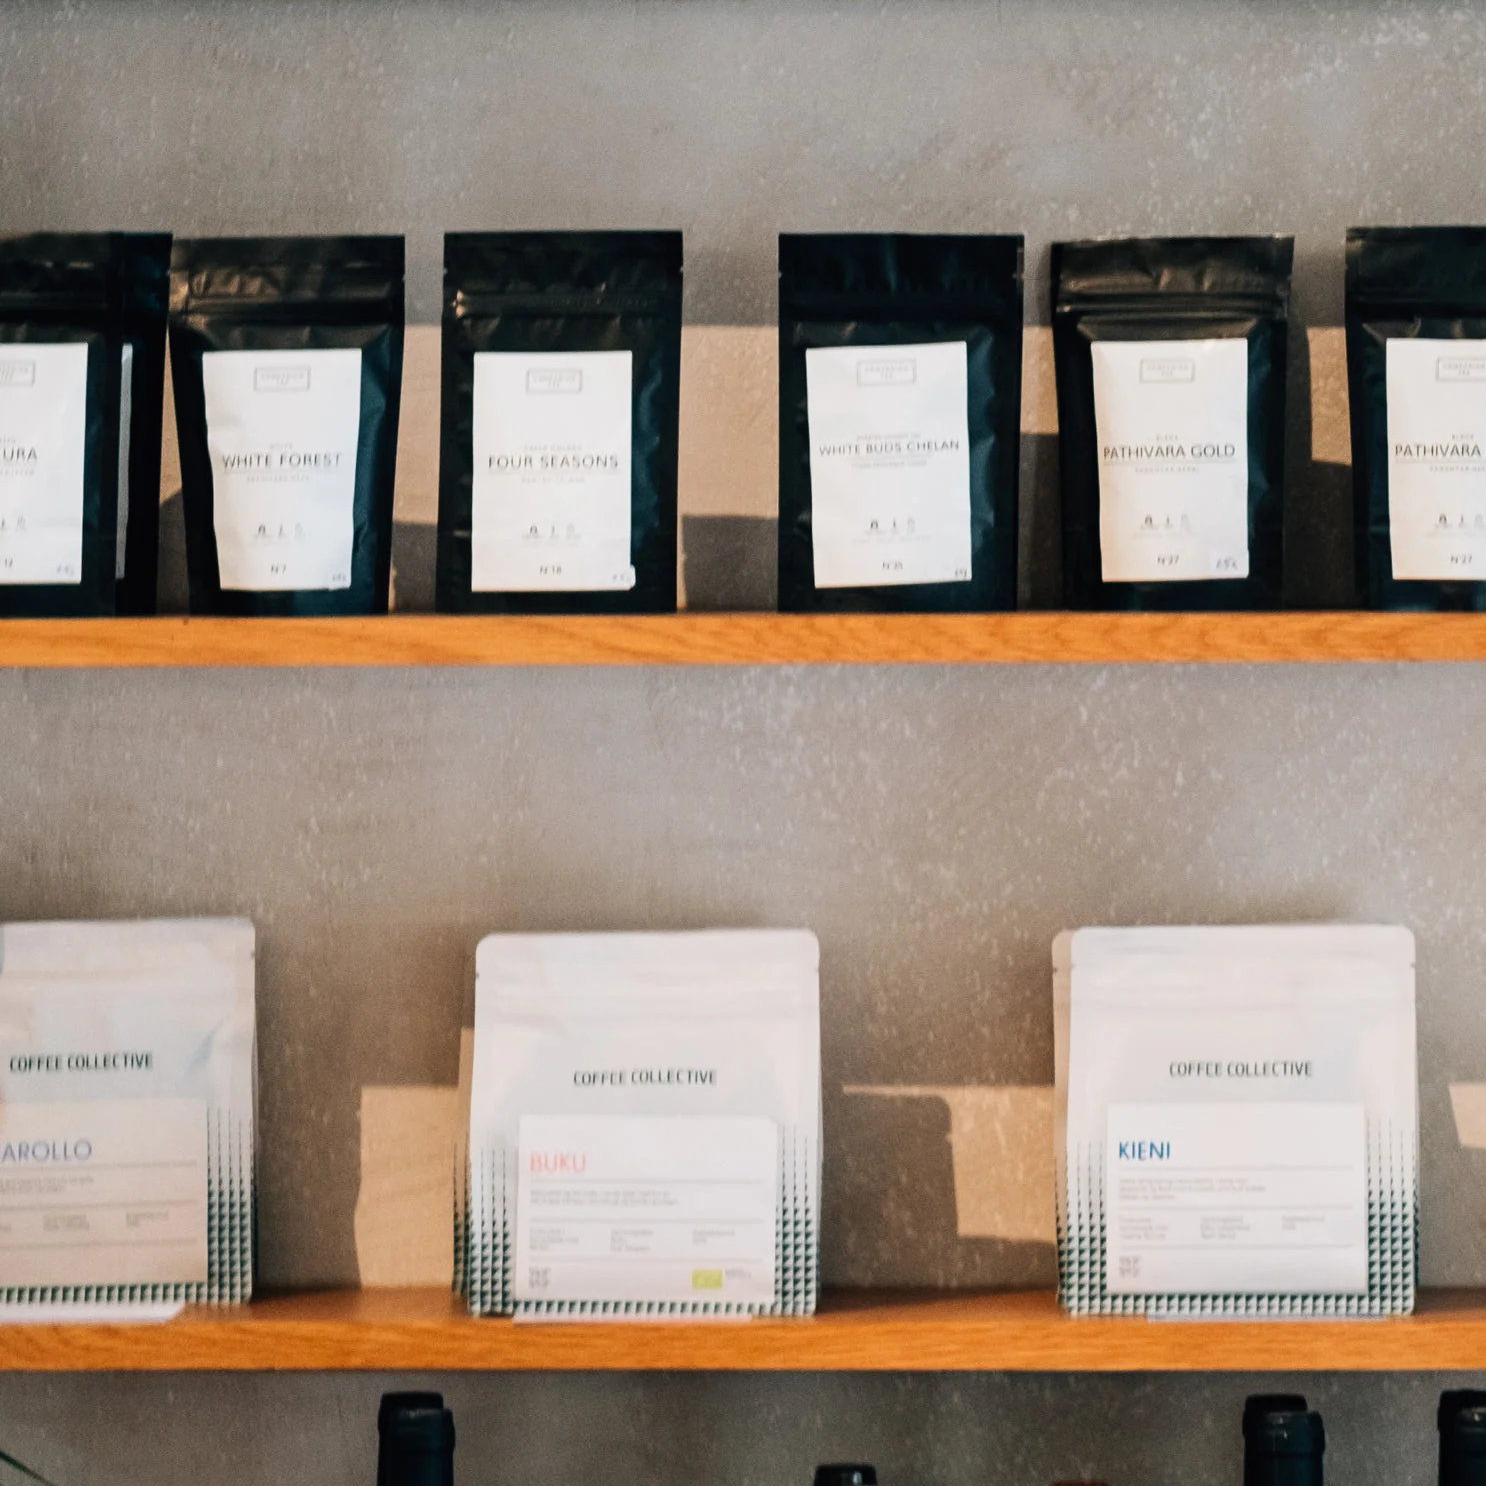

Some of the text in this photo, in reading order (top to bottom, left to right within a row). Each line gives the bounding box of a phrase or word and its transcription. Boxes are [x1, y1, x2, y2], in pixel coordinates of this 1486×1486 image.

[819, 438, 960, 457] WHITE BUDS CHELAN
[1103, 443, 1236, 461] PATHIVARA GOLD
[1395, 443, 1482, 459] PATHIVARA
[222, 451, 343, 470] WHITE FOREST
[488, 454, 619, 470] FOUR SEASONS
[10, 1051, 154, 1074] COFFEE COLLECTIVE
[1169, 1060, 1314, 1078] COFFEE COLLECTIVE
[573, 1068, 717, 1087] COFFEE COLLECTIVE
[1117, 1140, 1172, 1161] KIENI
[529, 1151, 588, 1175] BUKU
